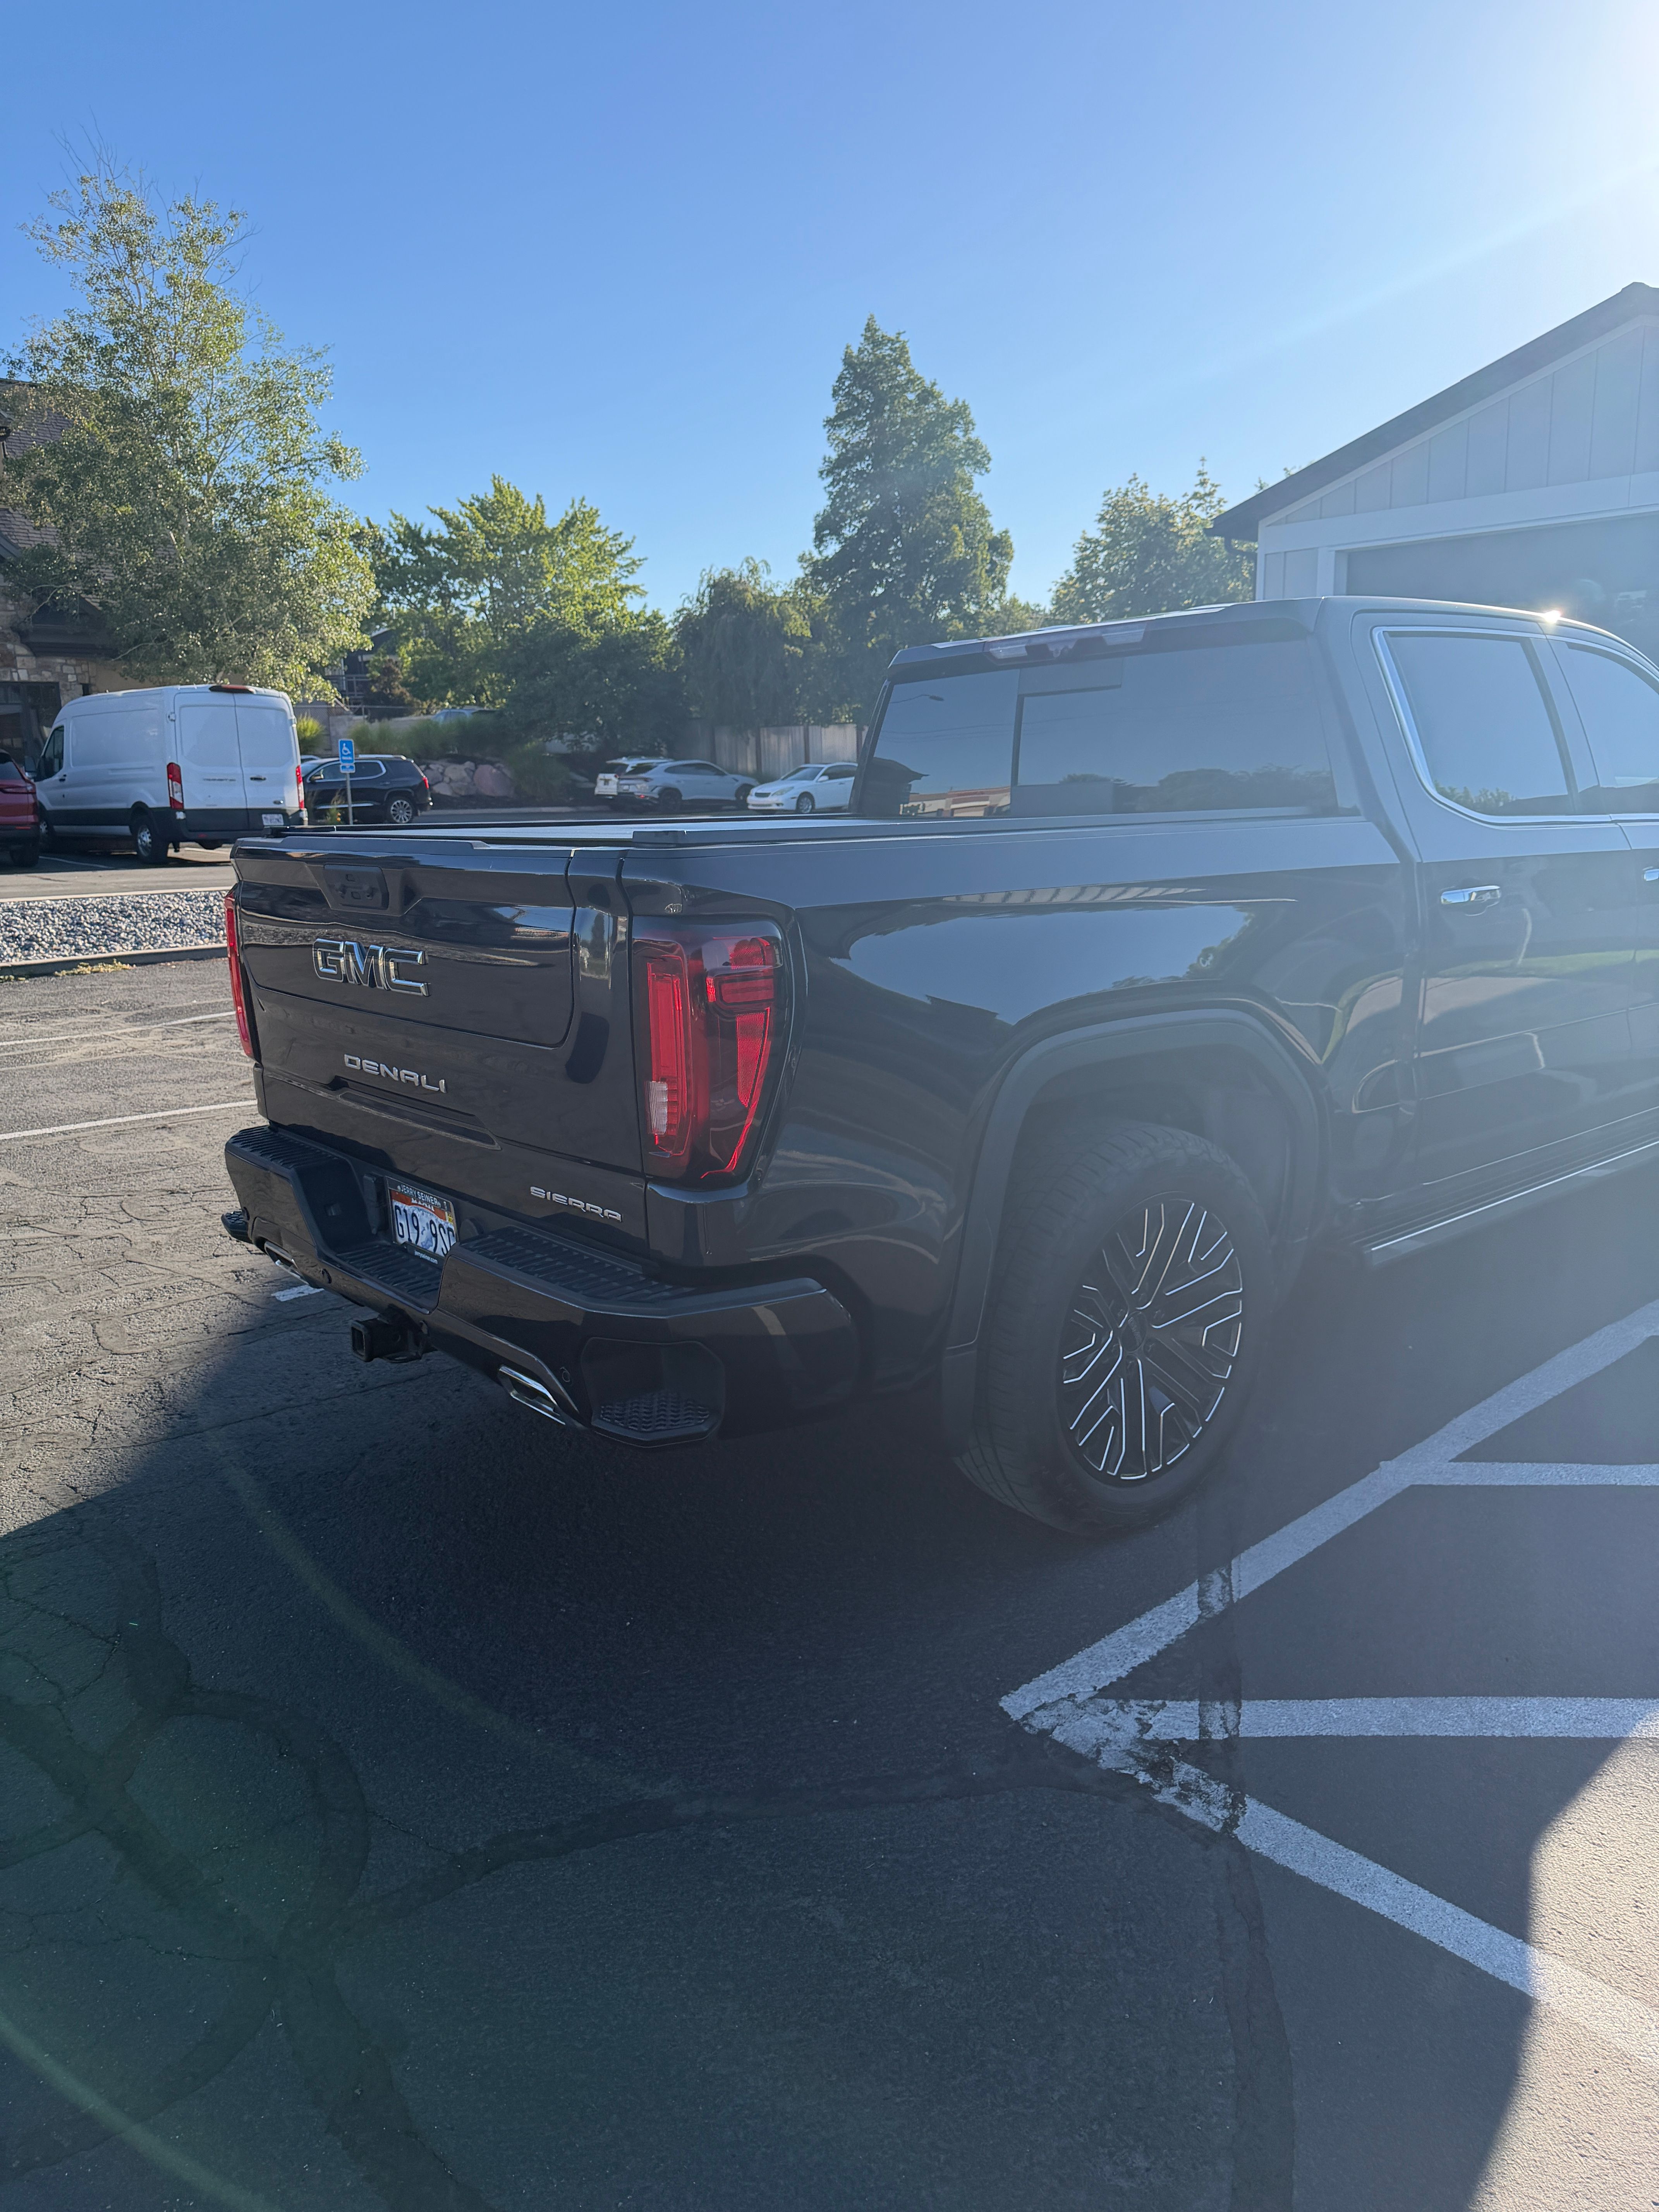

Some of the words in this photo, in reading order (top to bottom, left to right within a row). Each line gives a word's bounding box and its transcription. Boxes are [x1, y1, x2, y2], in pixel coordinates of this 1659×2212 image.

[312, 938, 431, 997] GMC
[344, 1054, 446, 1093] DENALI
[401, 1184, 416, 1197] JERRY
[417, 1191, 438, 1205] SEINER
[530, 1186, 622, 1222] SIERRA
[395, 1205, 419, 1245] G19
